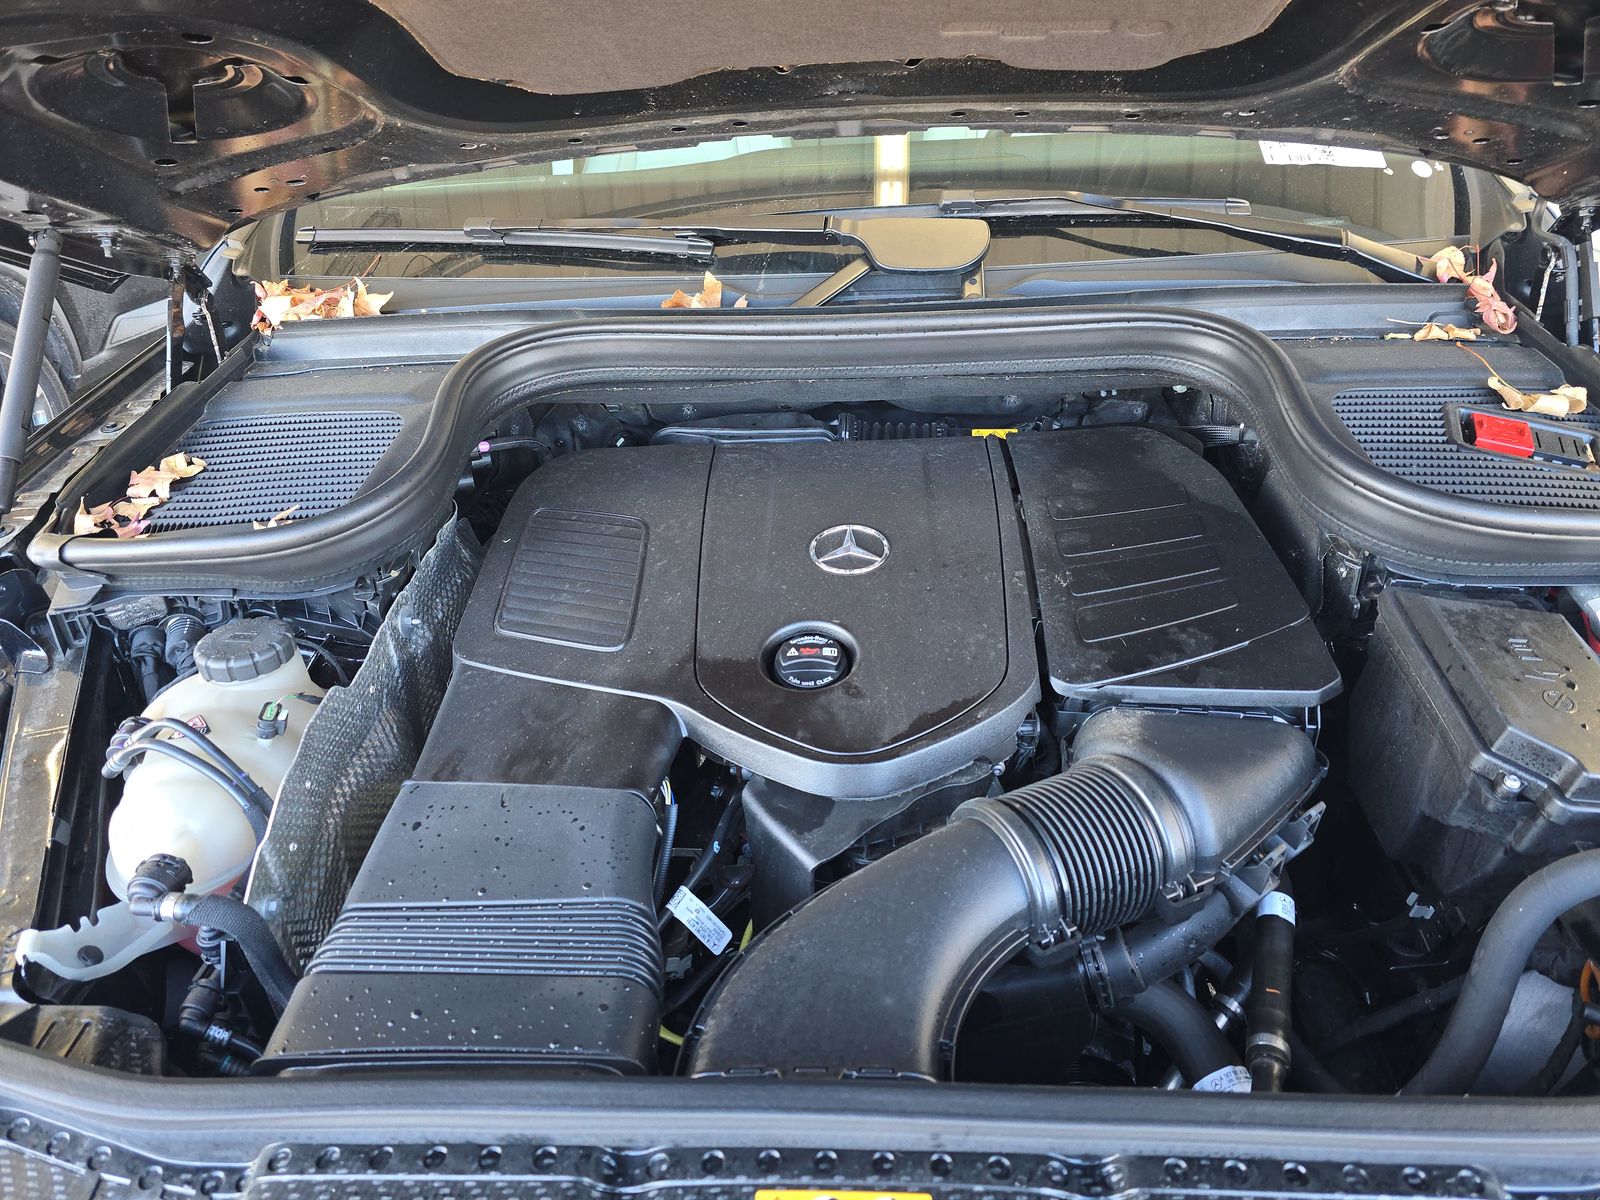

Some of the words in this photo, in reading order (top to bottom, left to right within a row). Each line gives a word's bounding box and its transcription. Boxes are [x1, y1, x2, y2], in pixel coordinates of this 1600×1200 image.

[788, 676, 801, 685] Turn
[816, 675, 834, 685] CLICK
[208, 1025, 231, 1041] TOP
